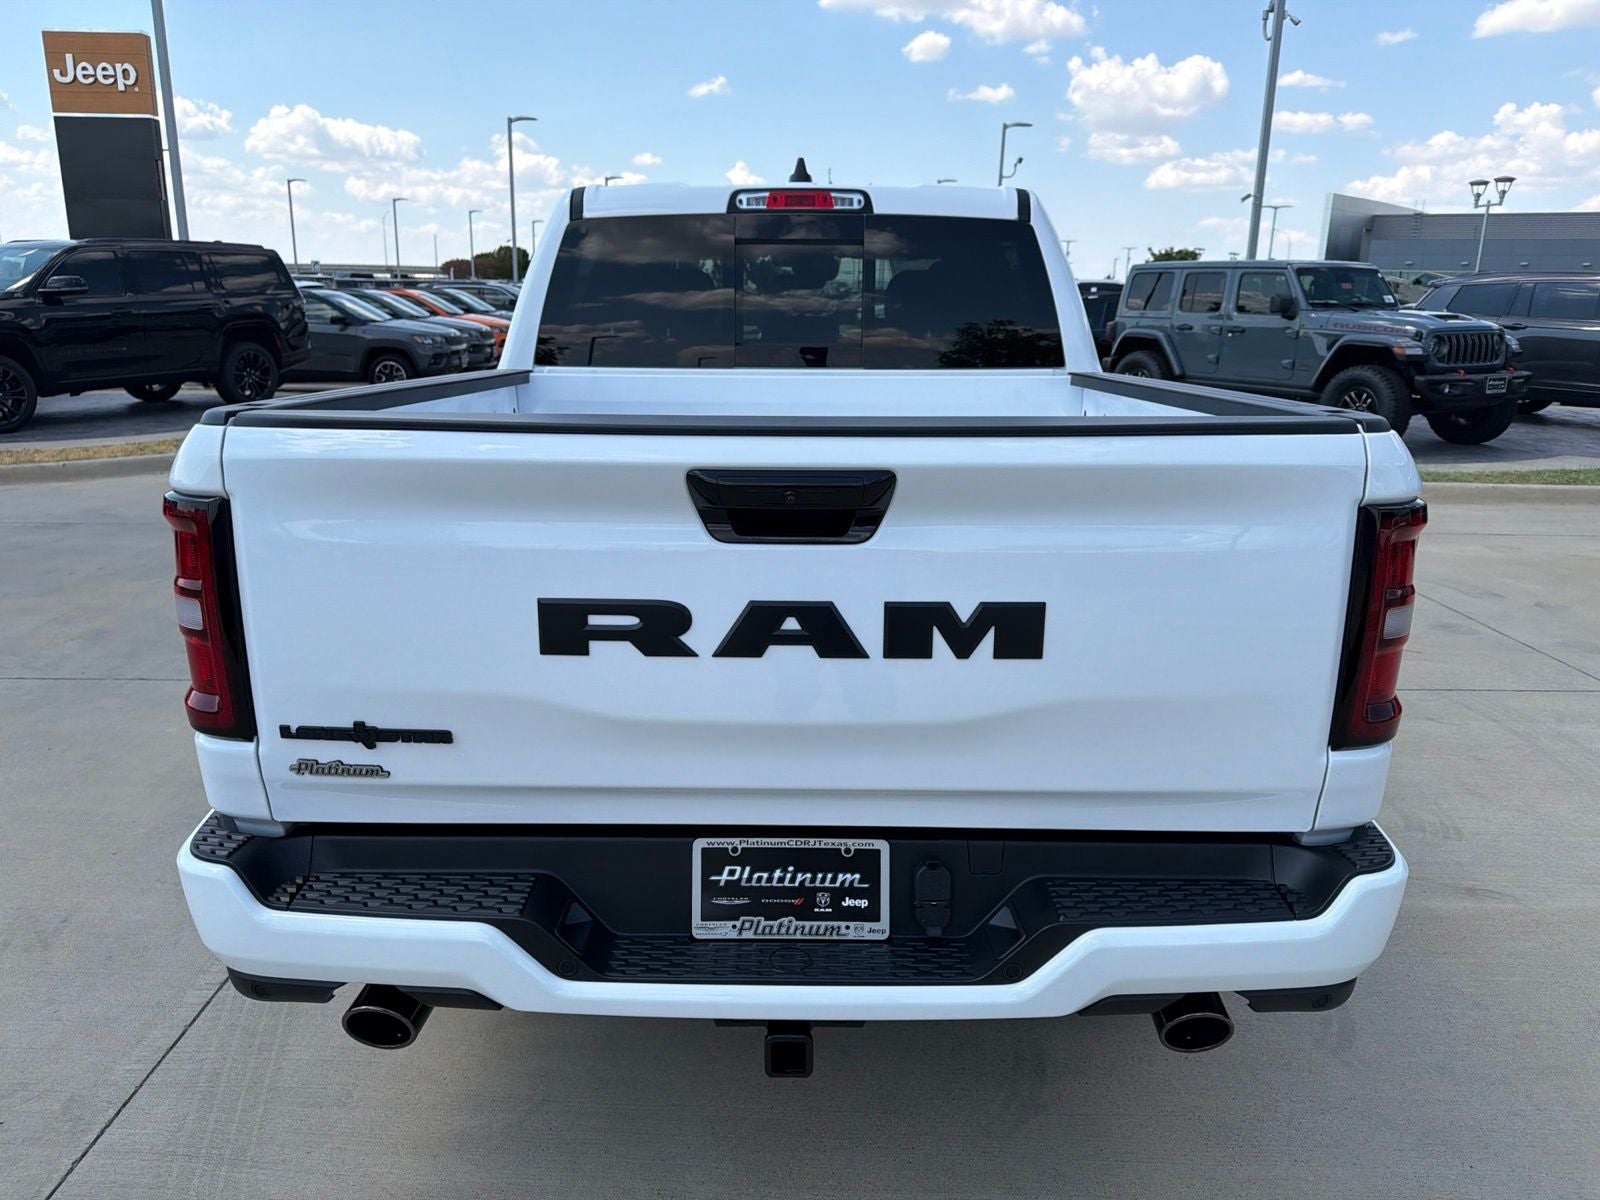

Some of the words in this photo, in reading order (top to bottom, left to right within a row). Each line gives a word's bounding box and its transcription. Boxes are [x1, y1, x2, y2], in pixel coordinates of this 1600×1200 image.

[53, 53, 137, 91] Jeep
[537, 598, 1046, 660] RAM
[289, 758, 391, 779] Platinum
[706, 839, 875, 848] www.PlatinumCDRJTexas.com
[708, 866, 870, 888] Platinum
[842, 896, 869, 909] Jeep
[737, 917, 848, 937] Platinum
[867, 927, 887, 935] Jeep
